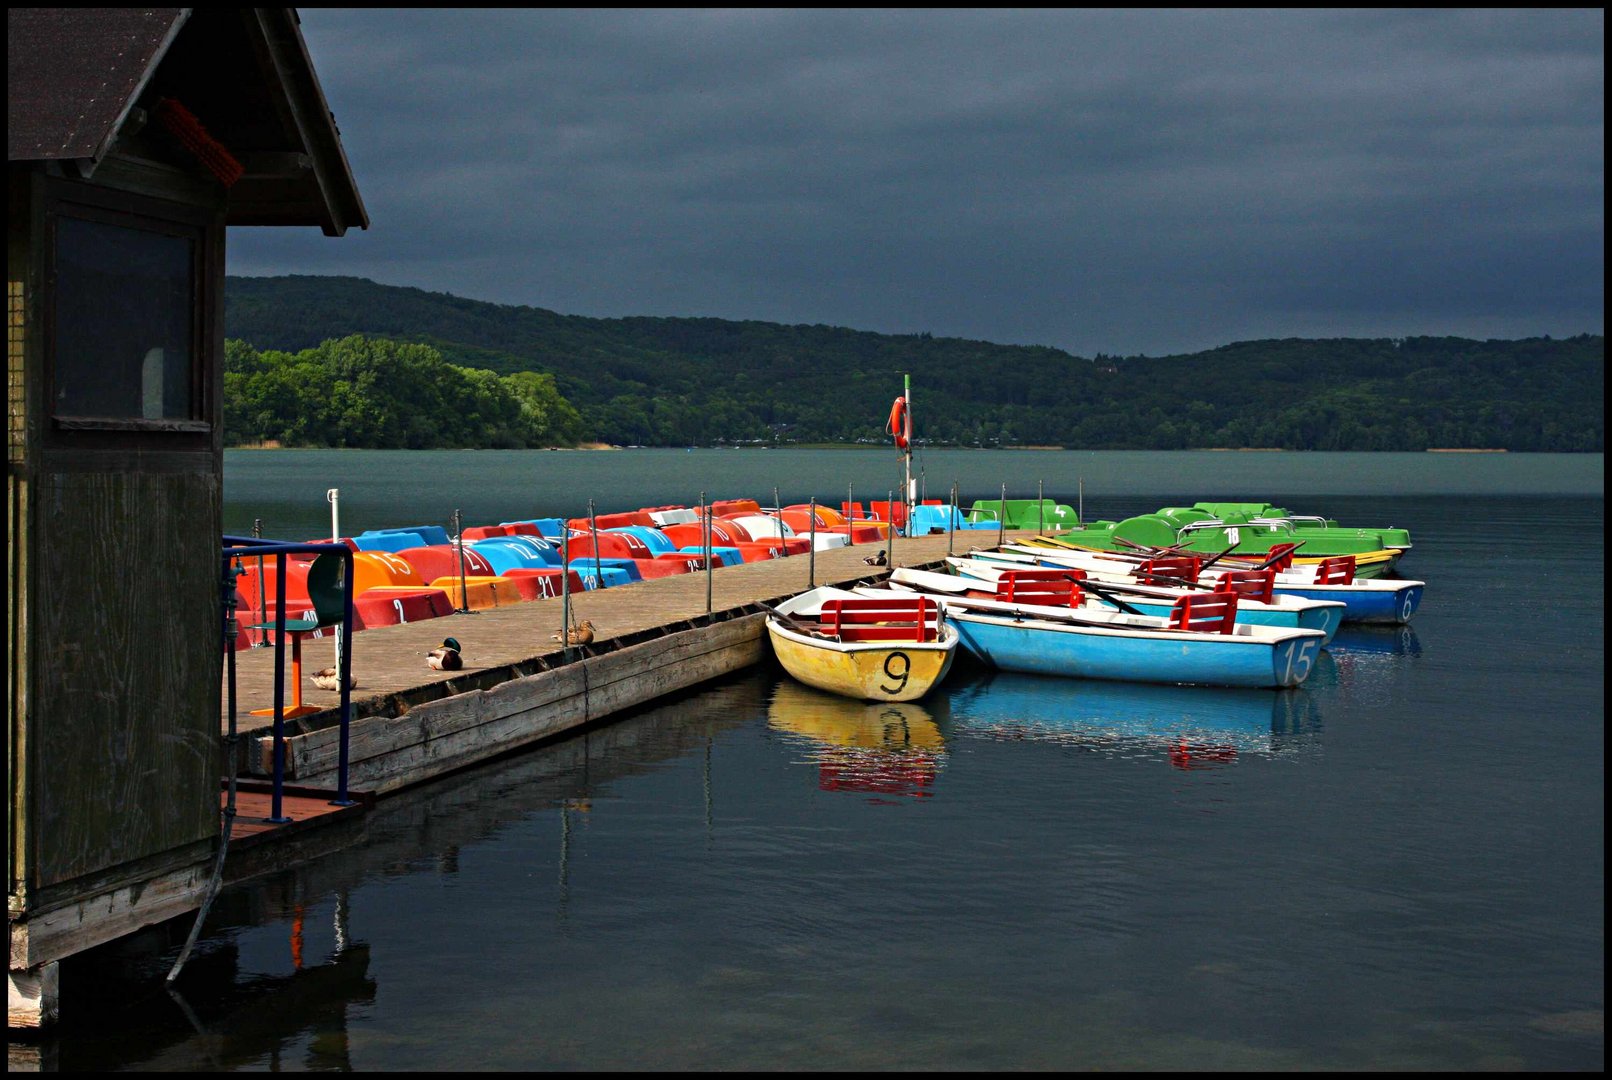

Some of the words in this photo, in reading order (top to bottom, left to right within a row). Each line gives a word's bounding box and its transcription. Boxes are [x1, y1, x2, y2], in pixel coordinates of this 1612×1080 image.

[1055, 506, 1066, 518] 4
[1223, 528, 1239, 544] 18
[504, 543, 539, 560] 12
[368, 553, 411, 575] 15
[538, 575, 556, 599] 21
[393, 599, 407, 624] 2
[1402, 589, 1414, 620] 6
[880, 651, 911, 695] 9
[1284, 640, 1316, 683] 15
